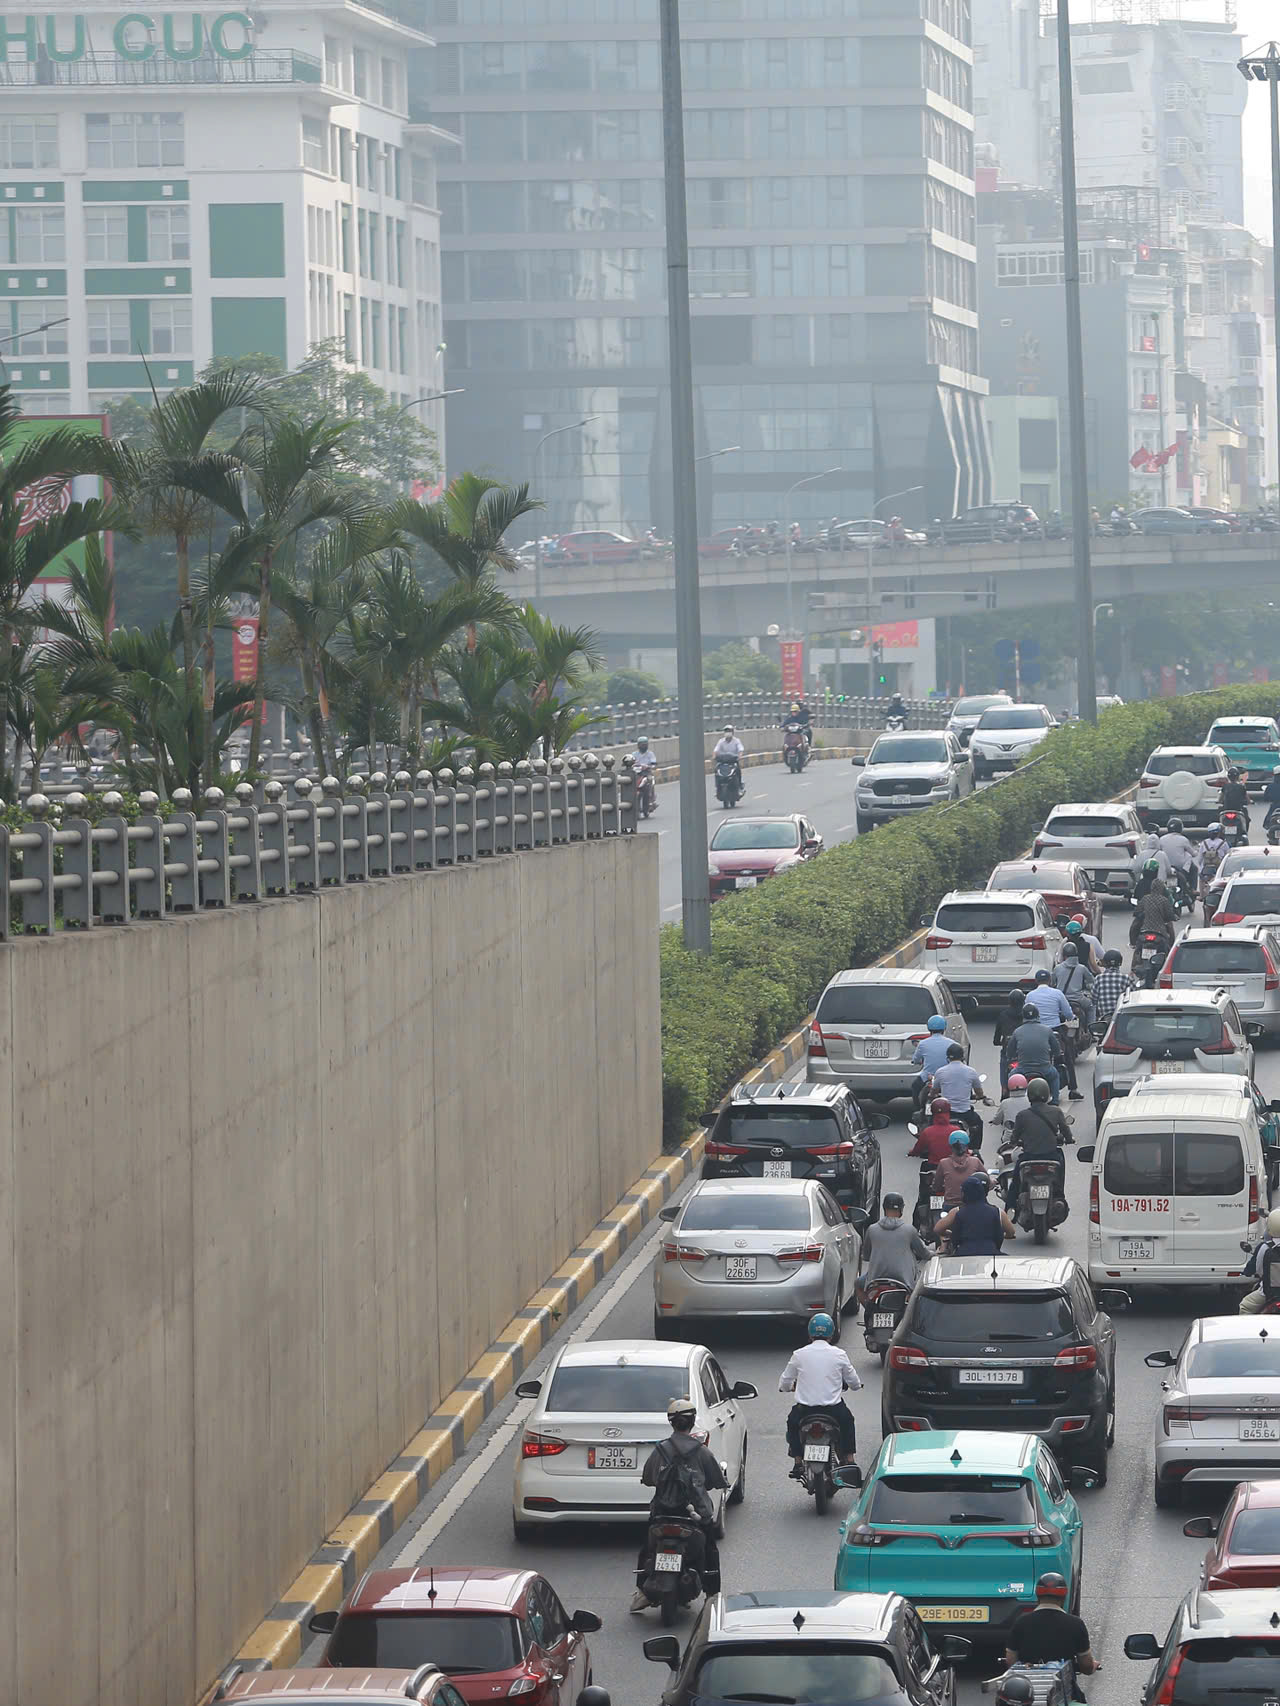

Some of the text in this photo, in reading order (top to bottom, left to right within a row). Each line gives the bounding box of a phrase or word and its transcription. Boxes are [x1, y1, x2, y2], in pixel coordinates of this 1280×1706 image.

[1110, 1199, 1170, 1213] 19A-791.52
[1130, 1242, 1144, 1250] 19A
[1123, 1250, 1150, 1258] 791.52
[733, 1258, 749, 1268] 30F
[727, 1268, 756, 1278] 226.65
[965, 1372, 1018, 1382] 30L-113.78
[1250, 1421, 1268, 1429] 98A
[1243, 1430, 1276, 1438] 845.64
[607, 1448, 624, 1457] 30K
[599, 1458, 633, 1467] 751.52
[922, 1608, 983, 1619] 29E-109.29
